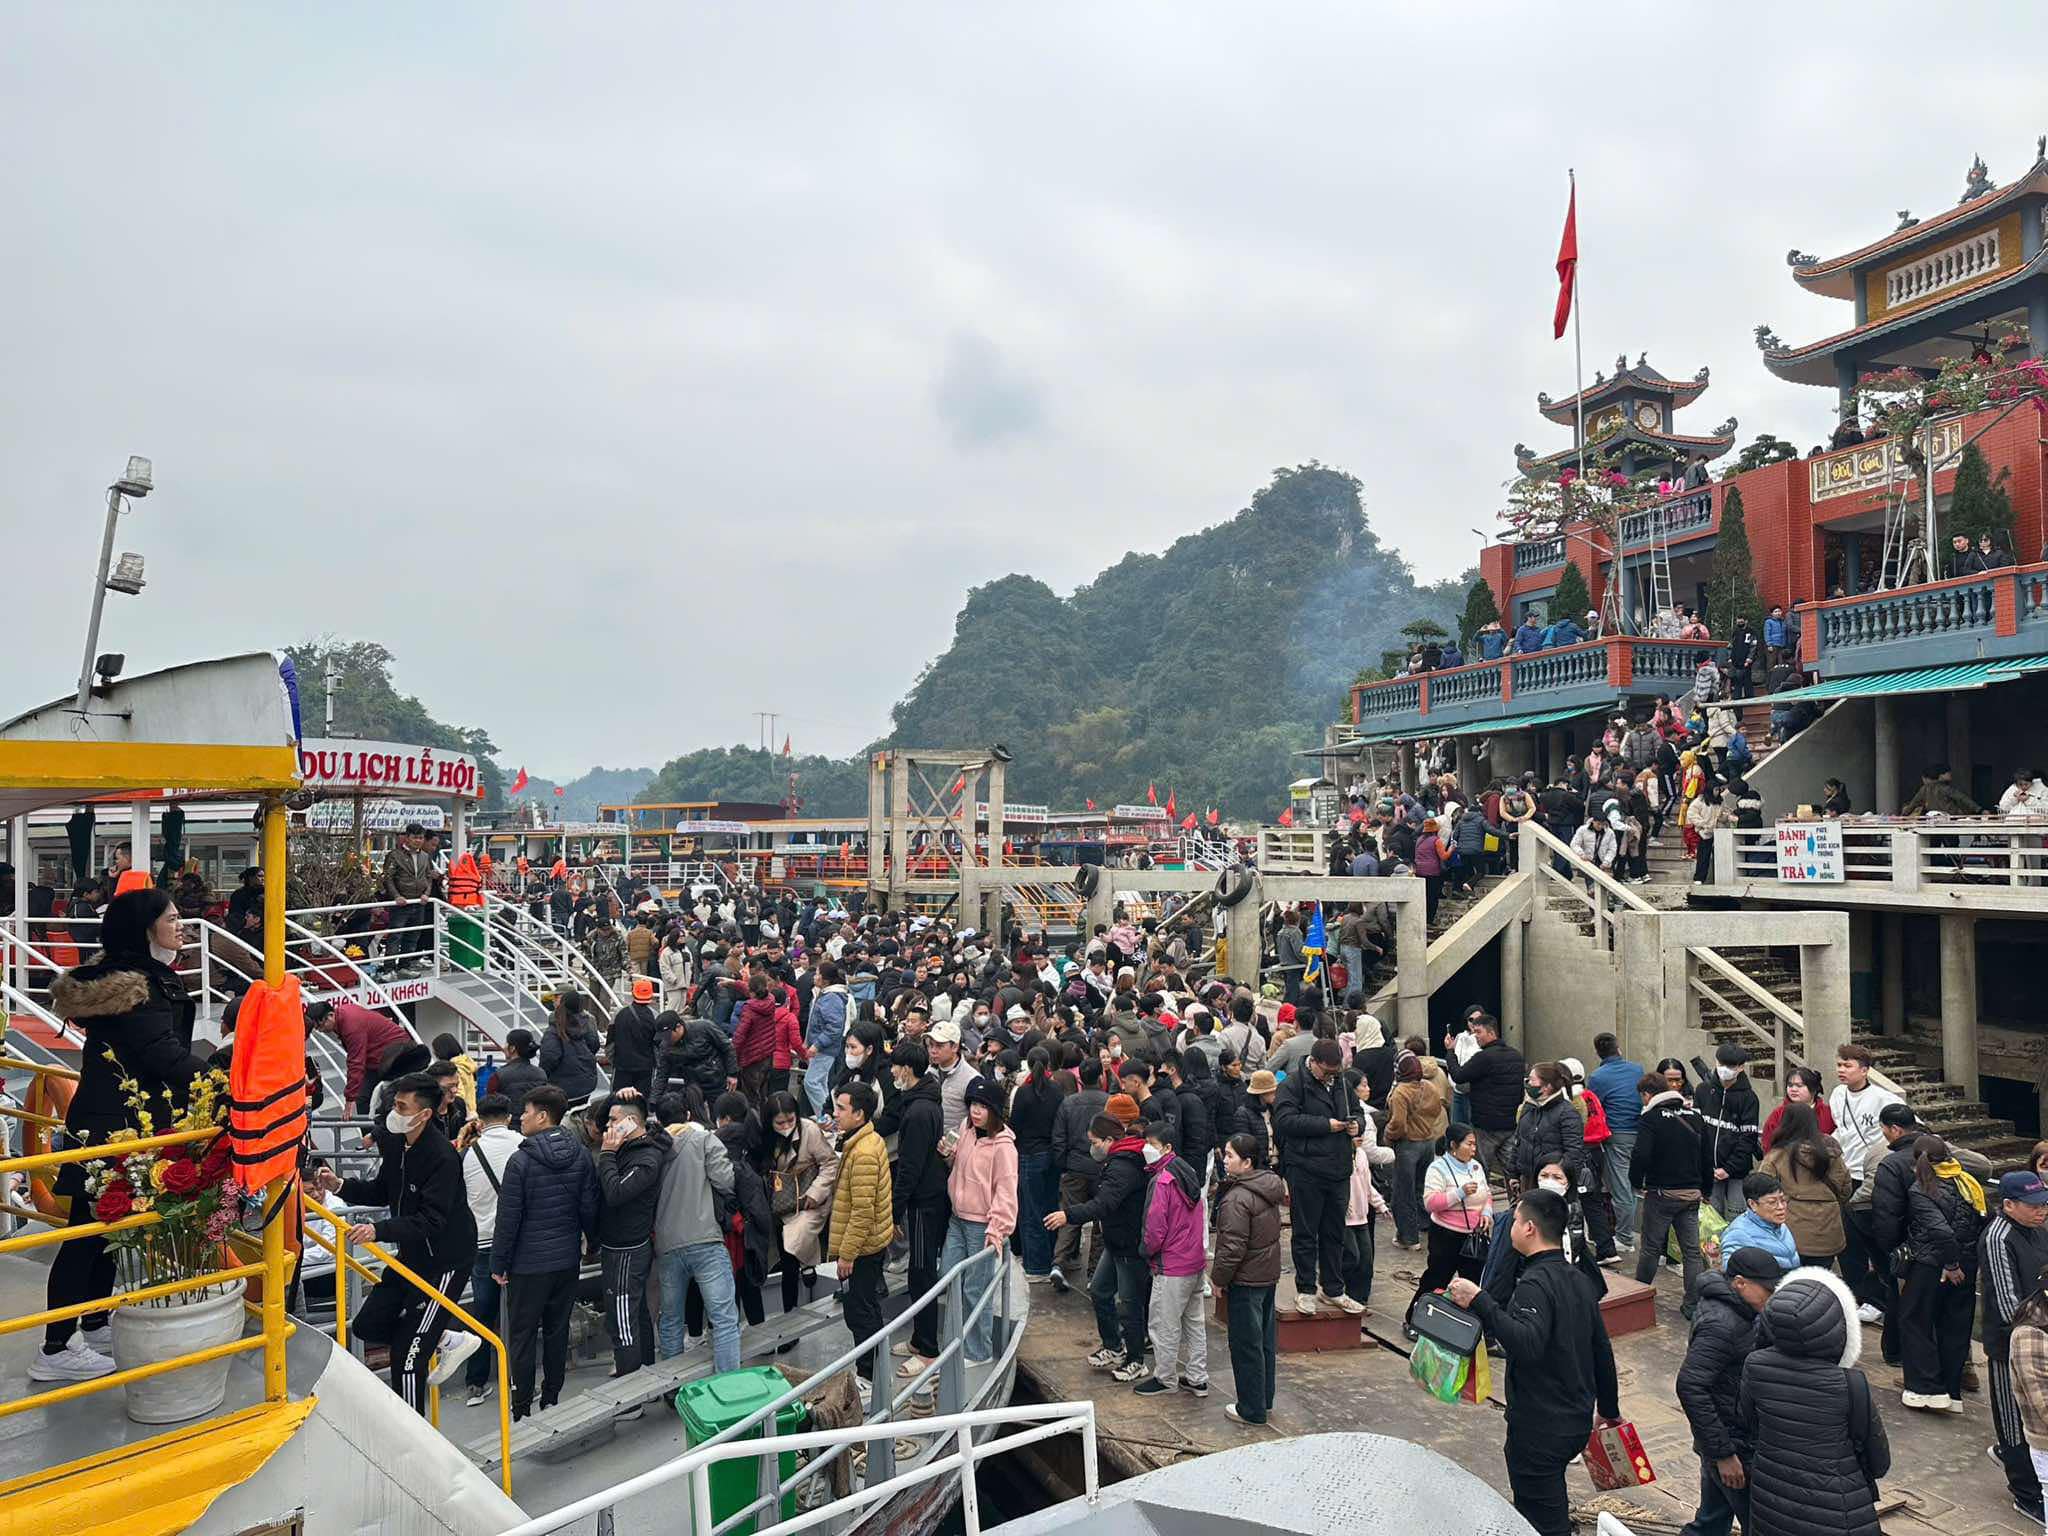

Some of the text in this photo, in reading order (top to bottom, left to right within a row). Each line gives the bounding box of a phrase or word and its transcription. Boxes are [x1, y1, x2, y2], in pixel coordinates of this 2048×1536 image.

[303, 748, 476, 794] DU LỊCH LỄ HỘI
[1778, 827, 1806, 841] BÁNH
[1782, 862, 1806, 879] TRÀ
[391, 980, 429, 1001] KHÁCH
[404, 1336, 422, 1371] adidas
